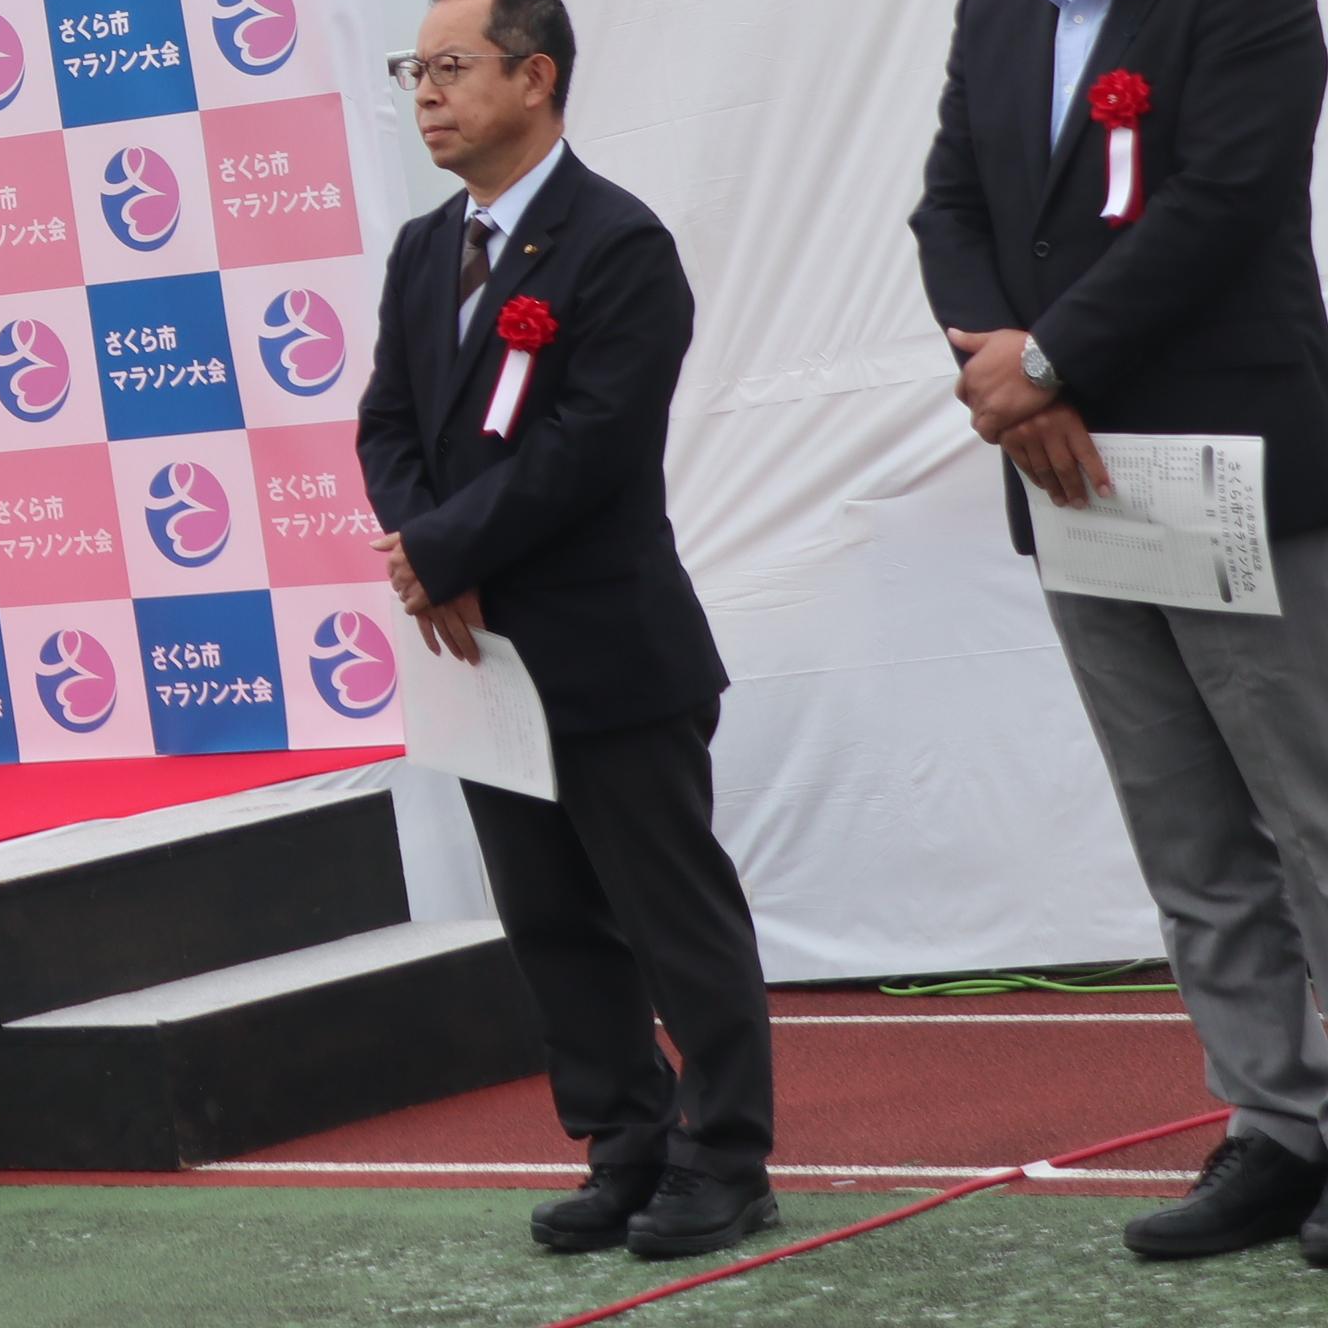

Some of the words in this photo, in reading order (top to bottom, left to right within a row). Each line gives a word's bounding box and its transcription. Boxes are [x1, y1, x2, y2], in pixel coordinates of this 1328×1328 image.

[59, 10, 130, 43] さくら市
[63, 41, 181, 77] マラソン大会
[219, 150, 290, 183] さくら市
[223, 182, 343, 218] マラソン大会
[106, 325, 177, 357] さくら市
[110, 358, 227, 391] マラソン大会
[267, 473, 337, 501] さくら市
[0, 528, 113, 559] マラソン大会
[152, 642, 221, 672] さくら市
[157, 676, 273, 707] マラソン大会
